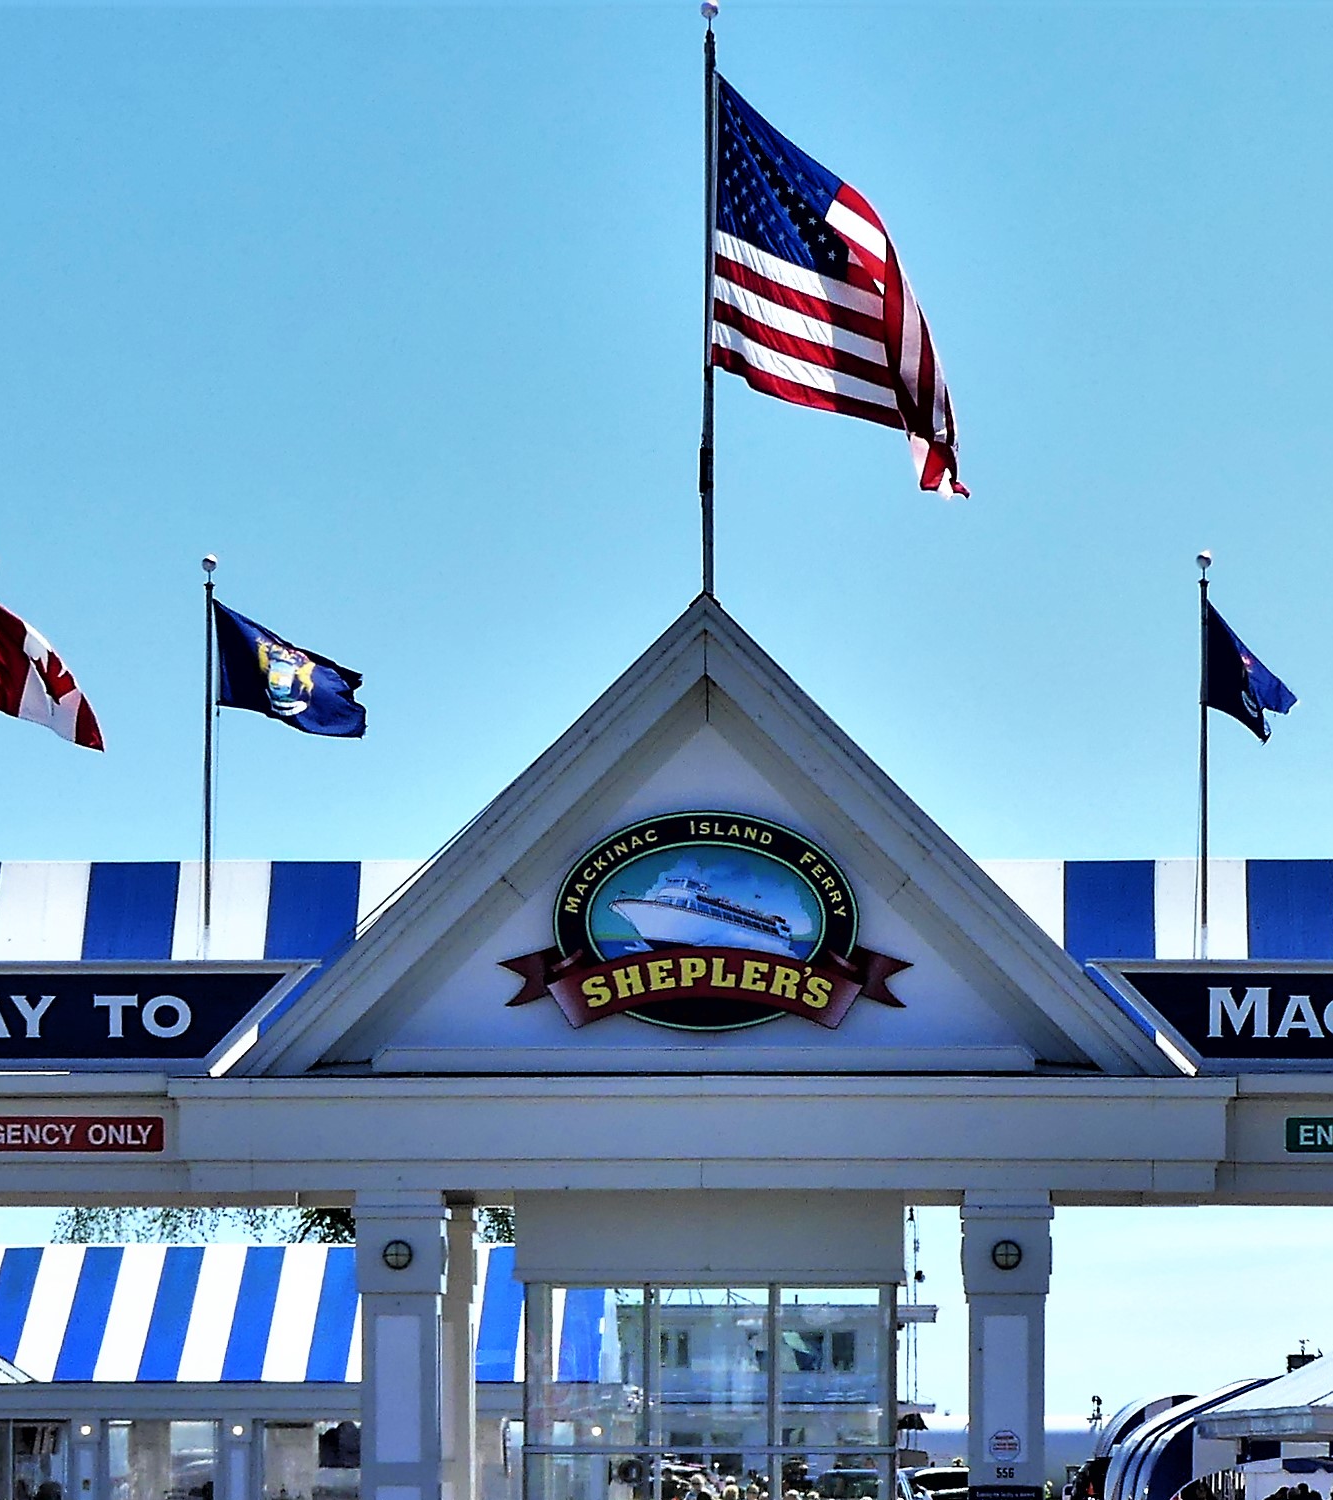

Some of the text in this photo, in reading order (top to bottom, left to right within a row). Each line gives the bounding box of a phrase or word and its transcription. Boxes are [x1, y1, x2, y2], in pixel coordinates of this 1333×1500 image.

[564, 819, 848, 918] MACKINAC ISLAND FERRY
[580, 956, 834, 1010] SHEPLER'S
[93, 993, 192, 1039] TO
[87, 1123, 153, 1146] ONLY
[996, 1467, 1015, 1479] 556
